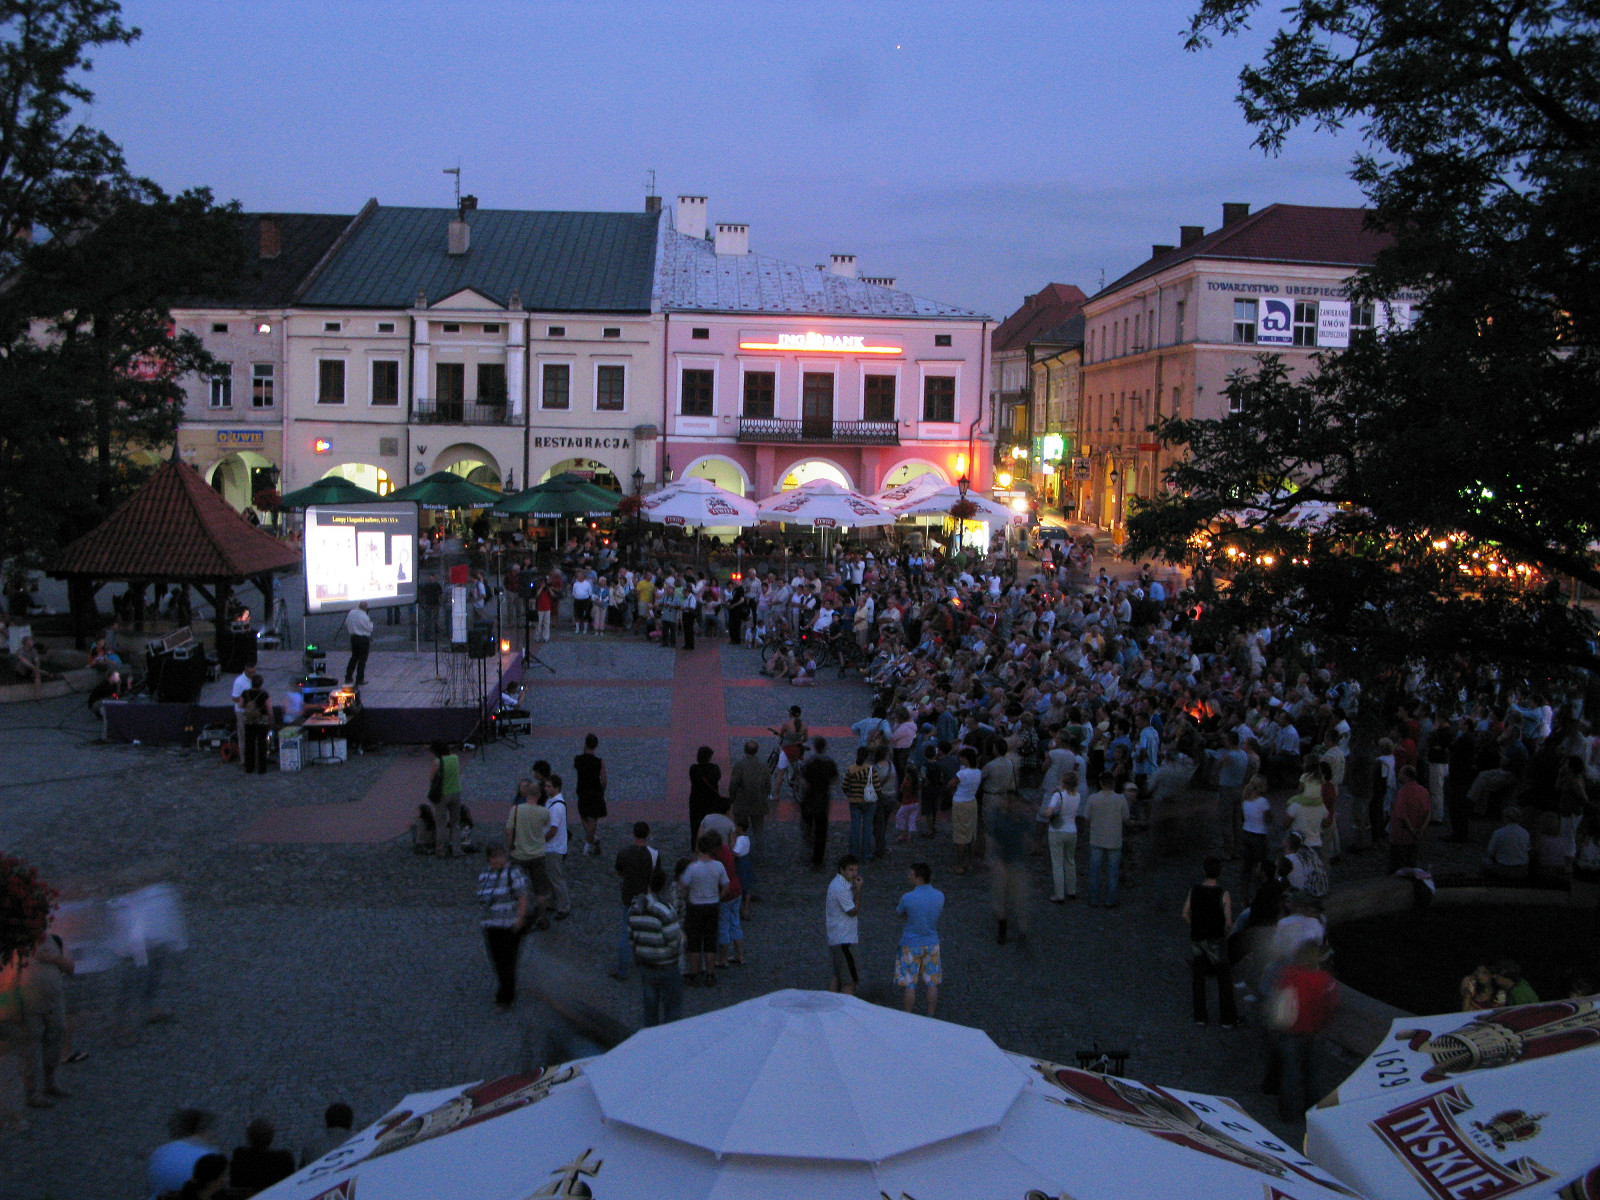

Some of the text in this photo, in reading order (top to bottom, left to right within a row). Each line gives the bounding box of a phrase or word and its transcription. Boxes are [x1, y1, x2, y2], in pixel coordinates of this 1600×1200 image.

[1207, 282, 1279, 294] TOWARZYSTWO
[1286, 286, 1352, 298] UBEZPIECZ
[1322, 319, 1346, 328] UMÓW
[778, 333, 865, 348] ING BANK
[534, 437, 630, 449] RESTAURACJA
[1373, 1049, 1410, 1088] 1629
[1390, 1106, 1505, 1200] TYSKIE
